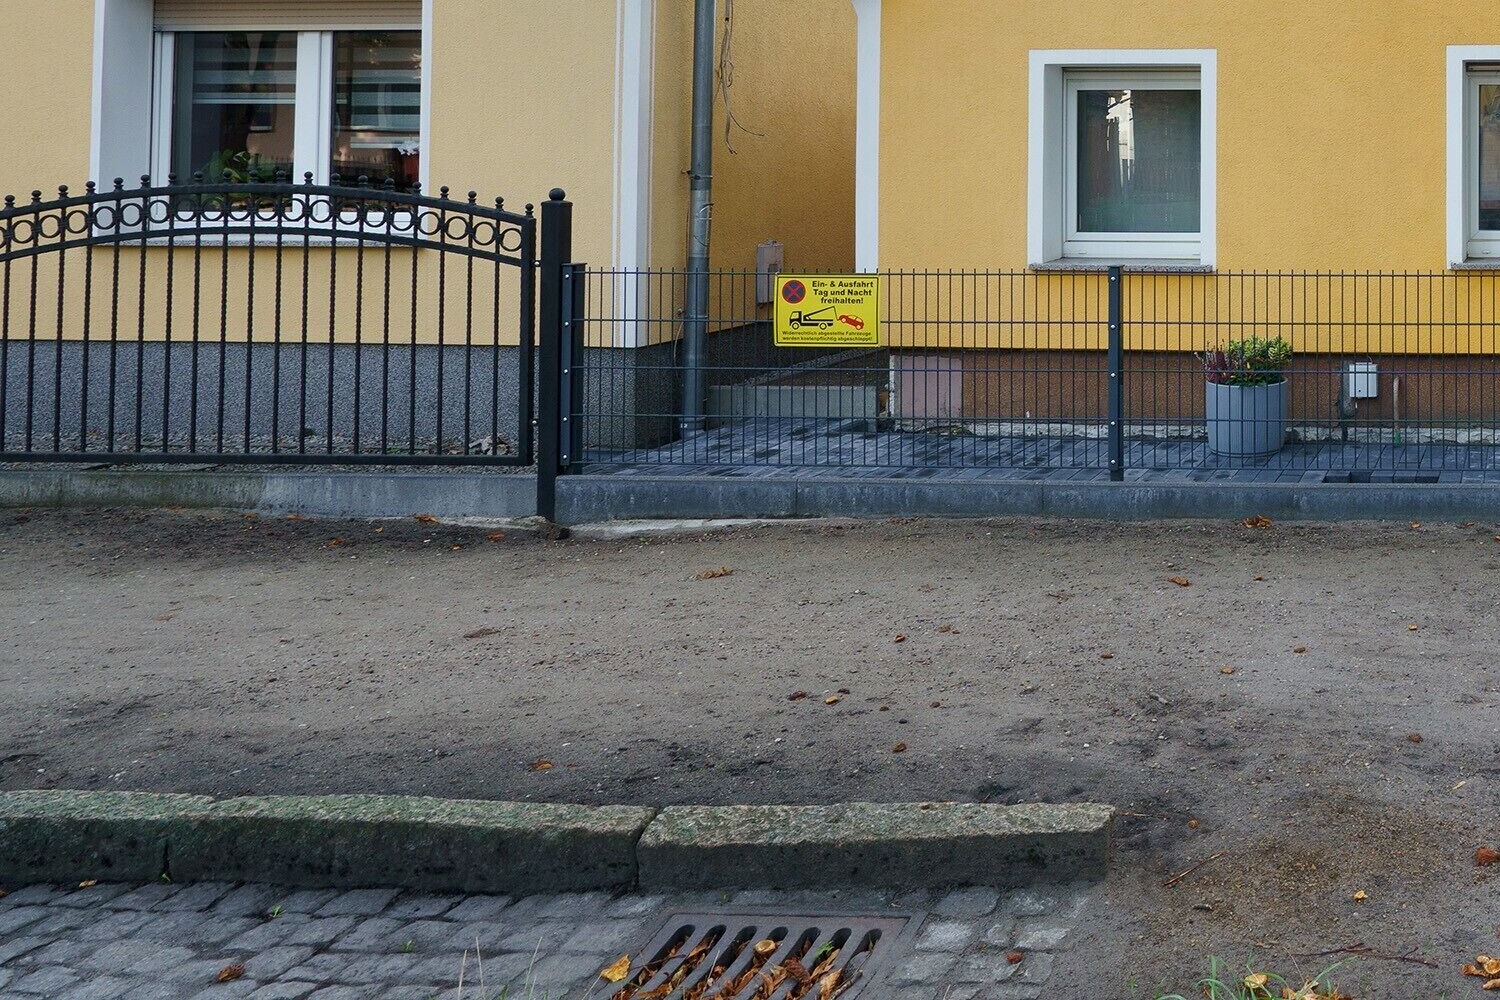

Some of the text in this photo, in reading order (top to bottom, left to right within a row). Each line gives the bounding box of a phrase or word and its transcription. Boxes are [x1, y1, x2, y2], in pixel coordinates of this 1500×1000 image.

[812, 280, 874, 288] Ein- & Ausfahrt
[813, 289, 828, 297] Tag
[847, 288, 872, 296] Nacht
